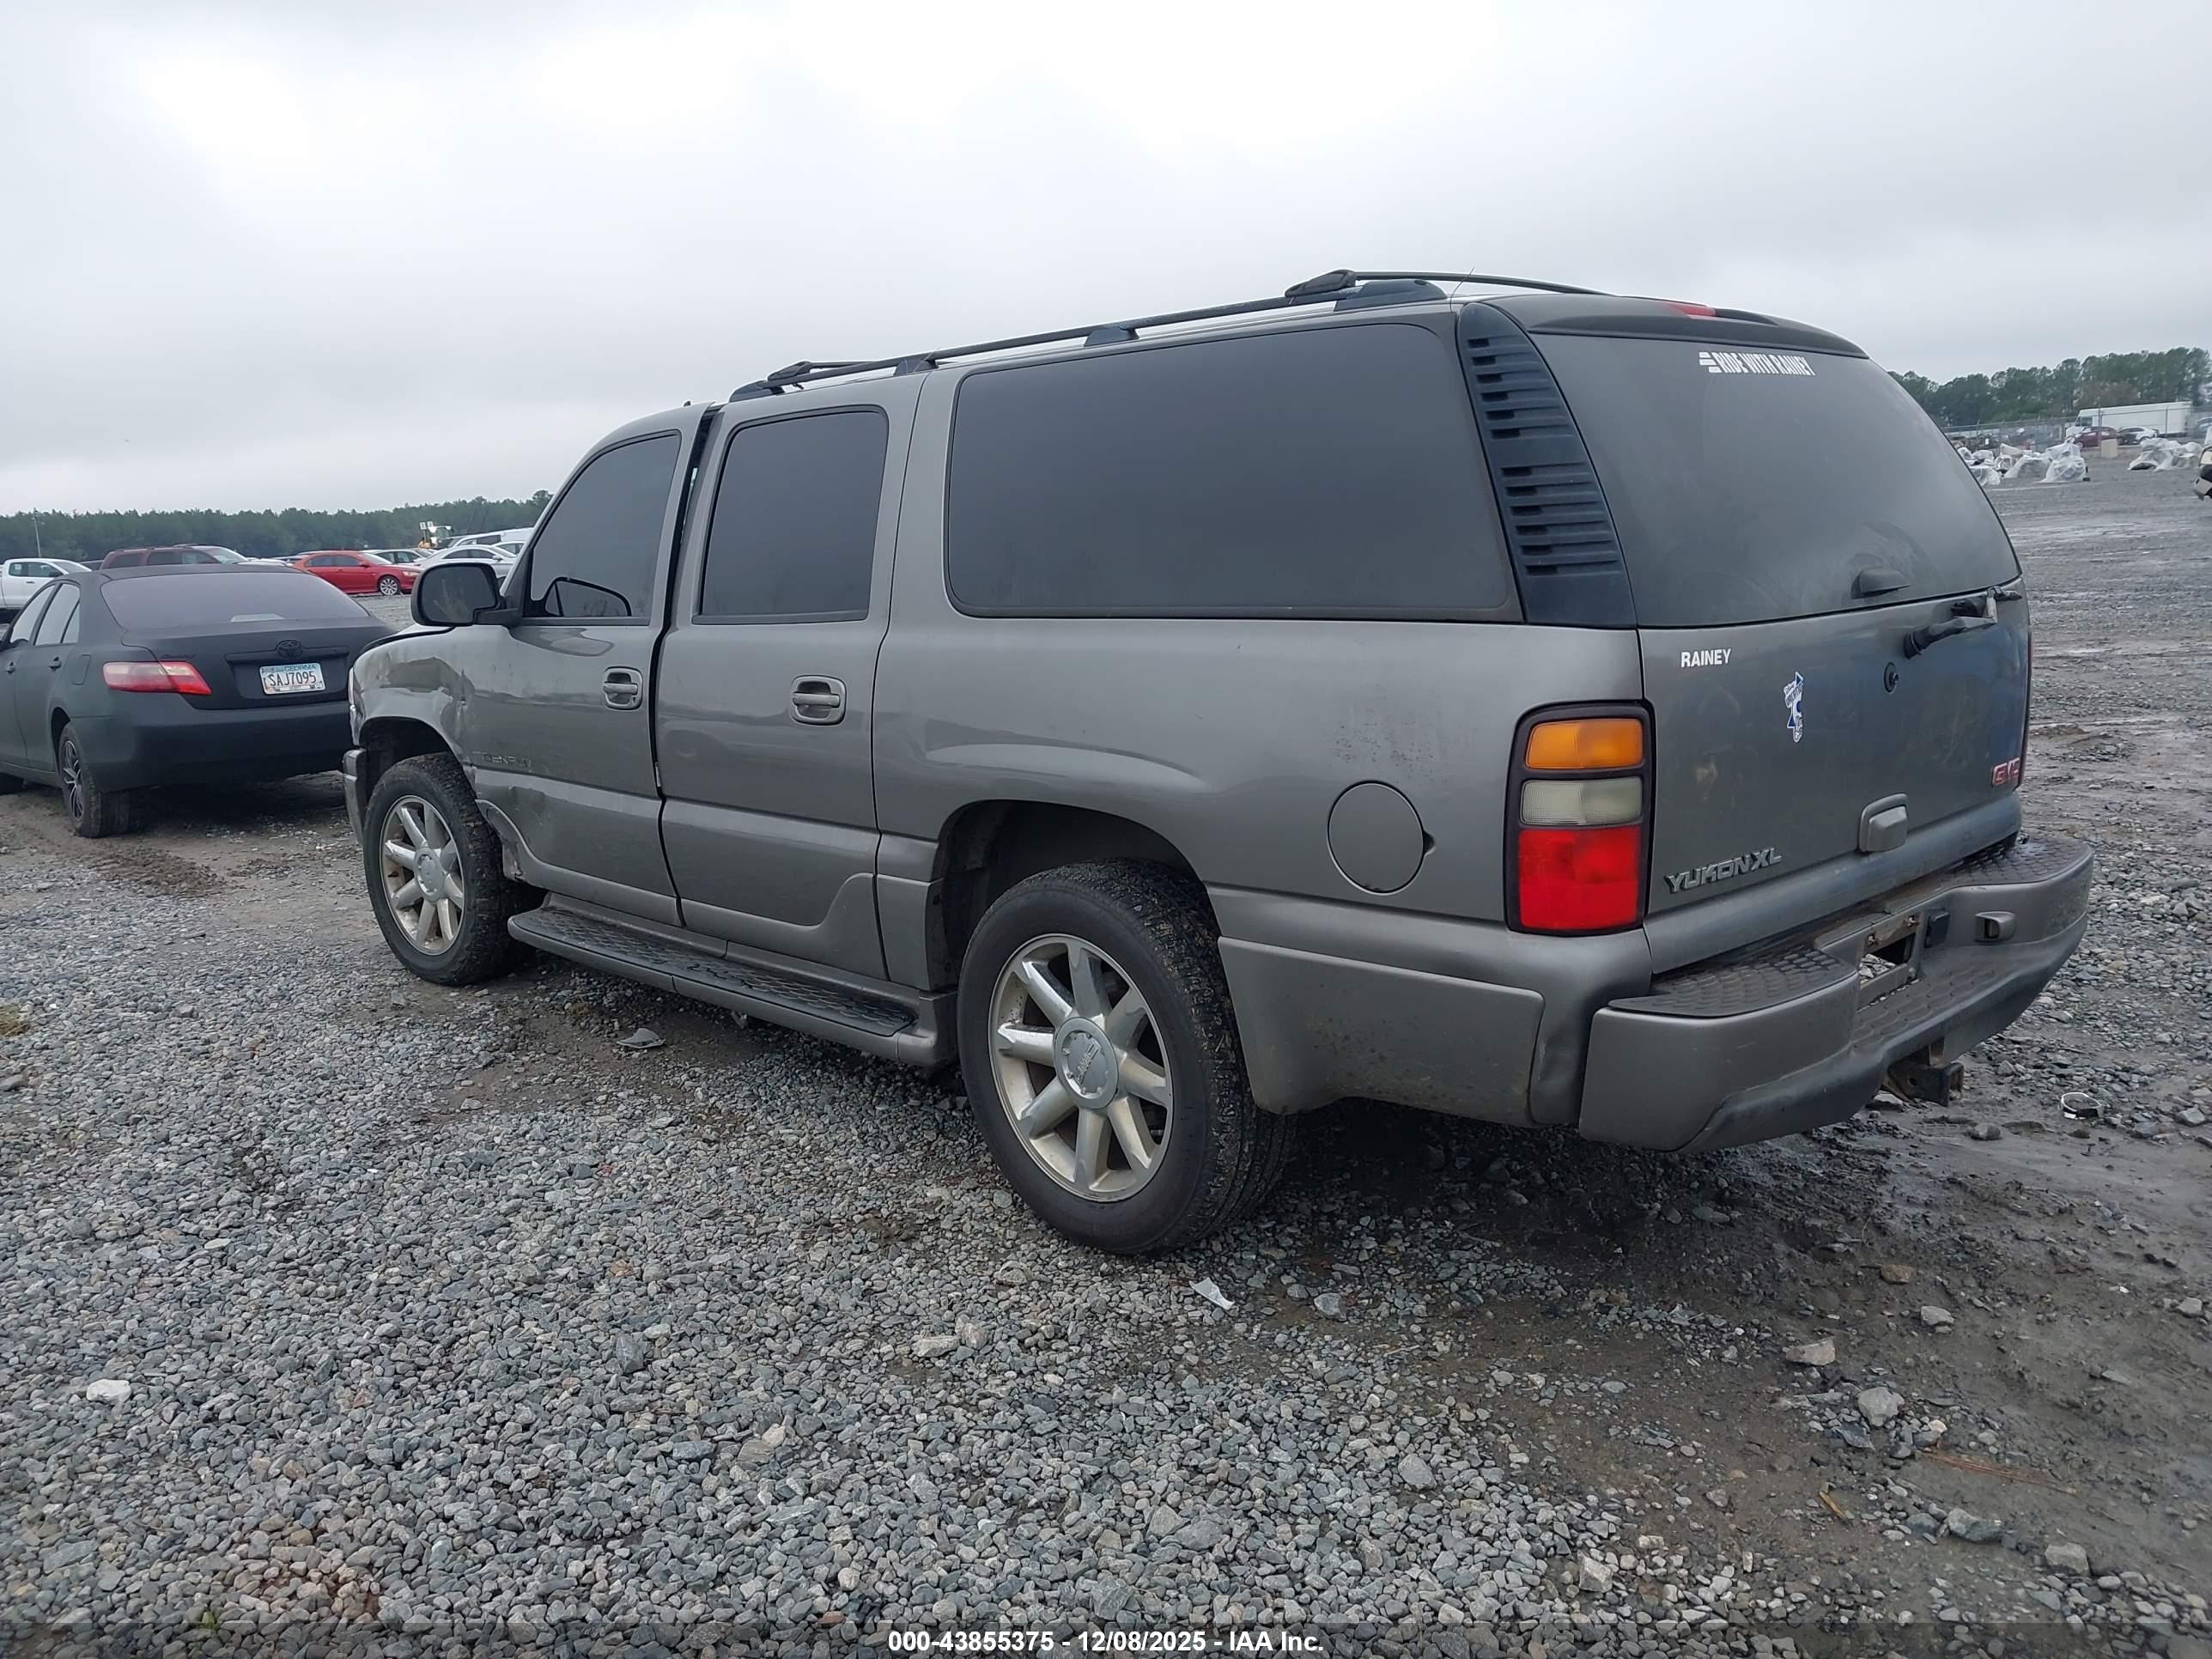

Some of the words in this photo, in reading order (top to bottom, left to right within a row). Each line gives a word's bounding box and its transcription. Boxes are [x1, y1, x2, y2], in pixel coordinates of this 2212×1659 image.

[1711, 352, 1749, 374] RIDE
[1737, 353, 1779, 374] WITH
[1769, 355, 1816, 376] RAINEY
[1680, 647, 1732, 669] RAINEY
[267, 671, 317, 687] SAJ7095
